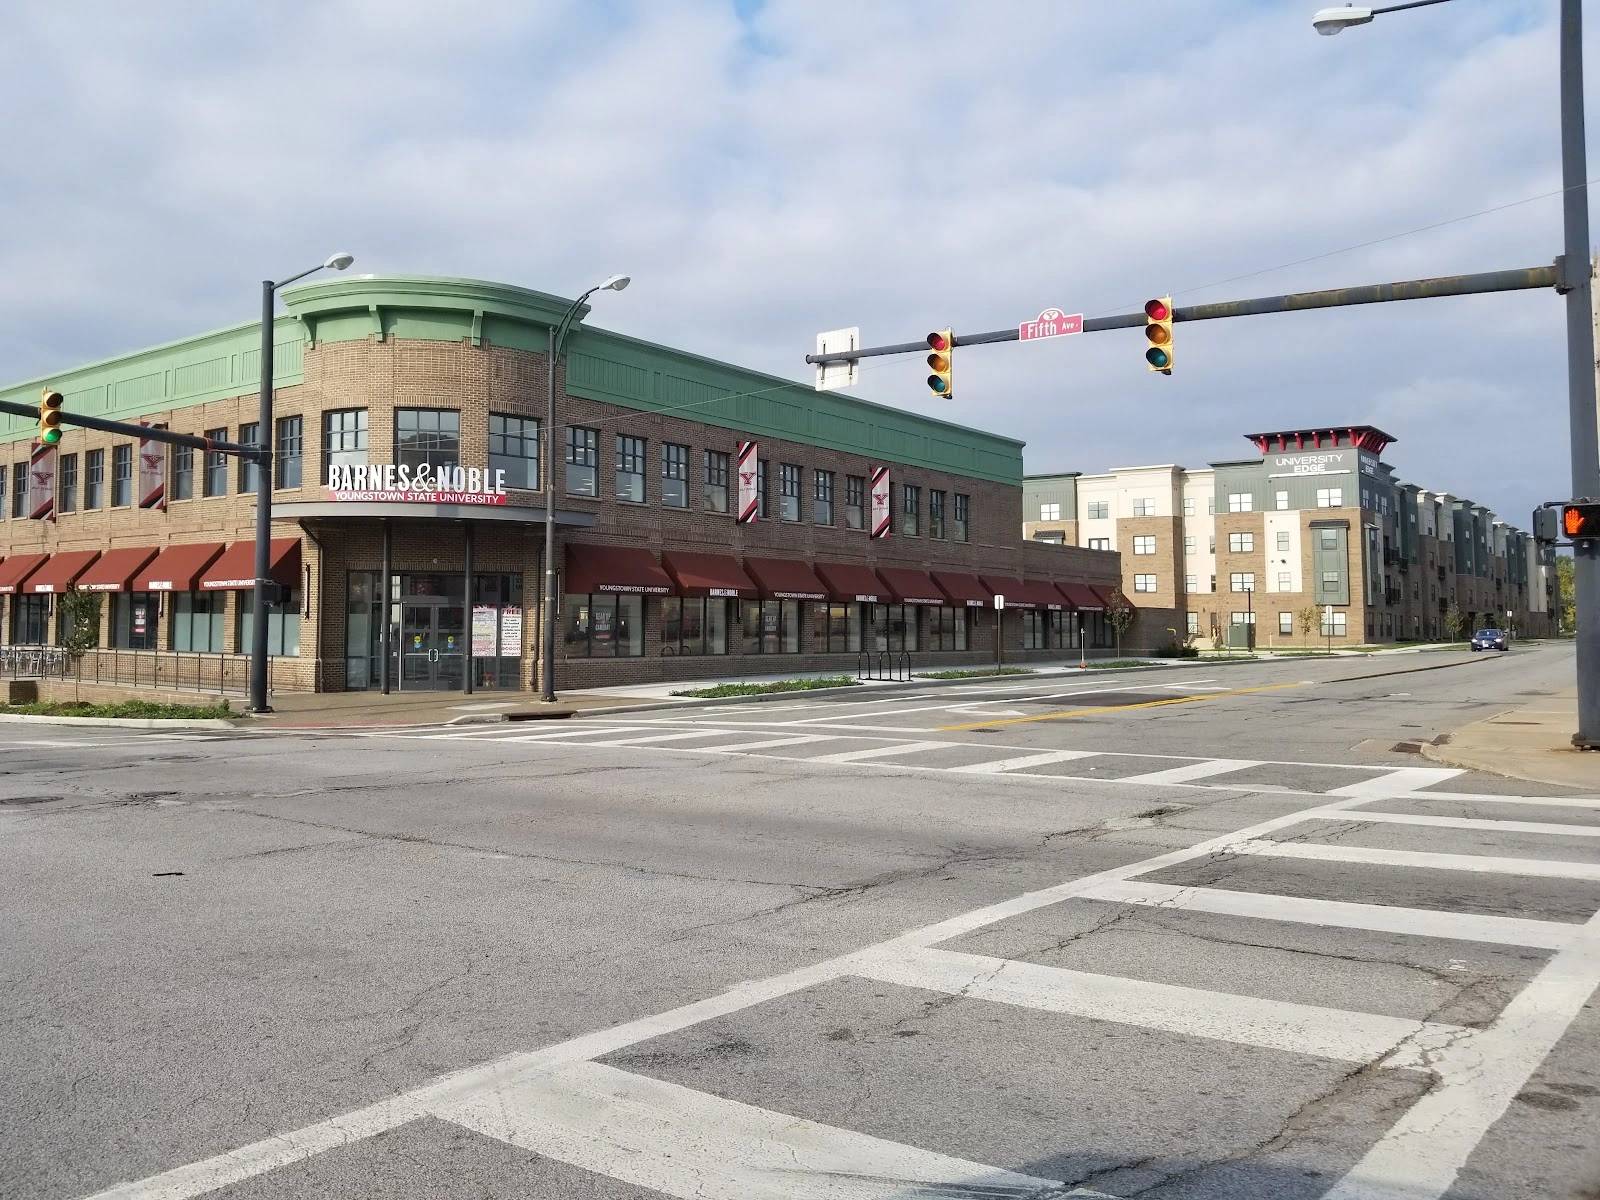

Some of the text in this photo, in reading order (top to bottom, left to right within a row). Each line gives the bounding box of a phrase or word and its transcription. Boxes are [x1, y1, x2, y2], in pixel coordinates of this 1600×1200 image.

[1027, 321, 1075, 339] Fifth Ave
[1276, 454, 1343, 466] UNIVERSITY
[1294, 464, 1325, 473] EDGE
[334, 491, 500, 503] YOUNGSTOWN STATE UNIVERSITY
